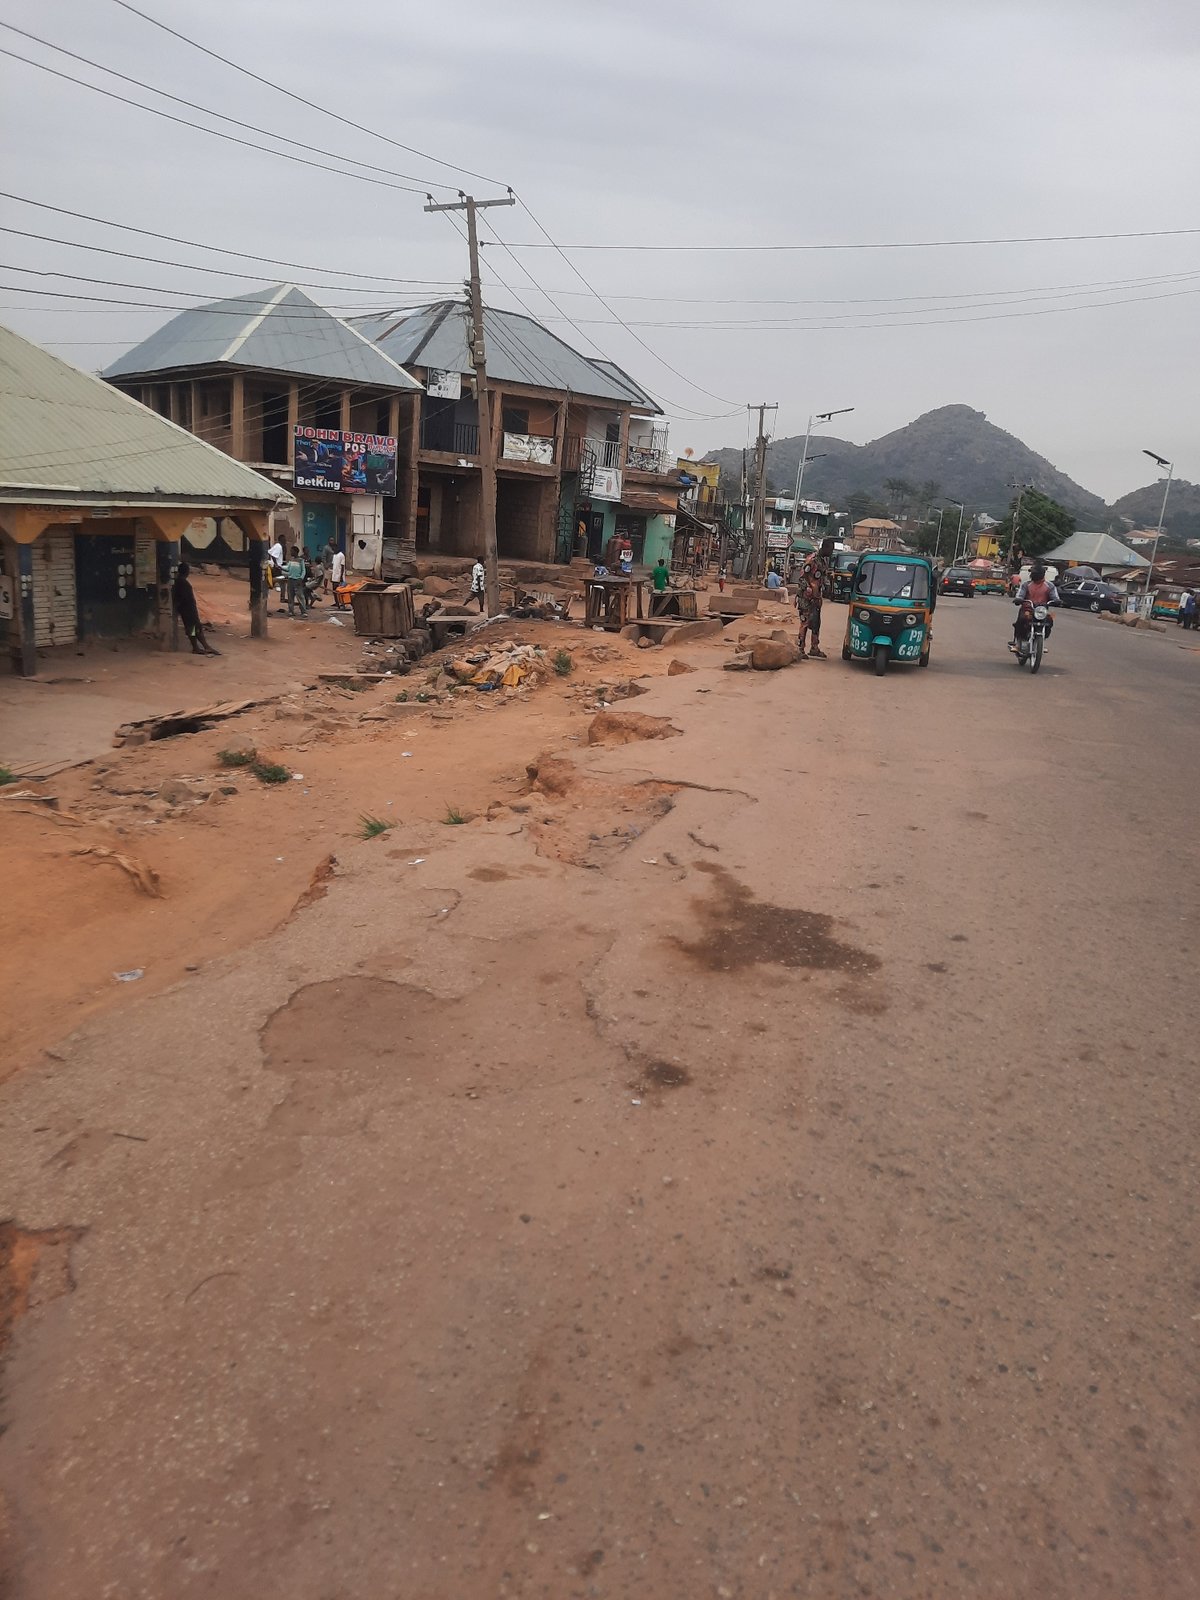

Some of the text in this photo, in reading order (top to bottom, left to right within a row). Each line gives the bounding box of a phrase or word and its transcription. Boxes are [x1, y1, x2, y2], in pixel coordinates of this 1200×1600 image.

[295, 425, 397, 446] JOHN BRAVO
[344, 443, 366, 453] POS
[297, 476, 340, 490] BetKing
